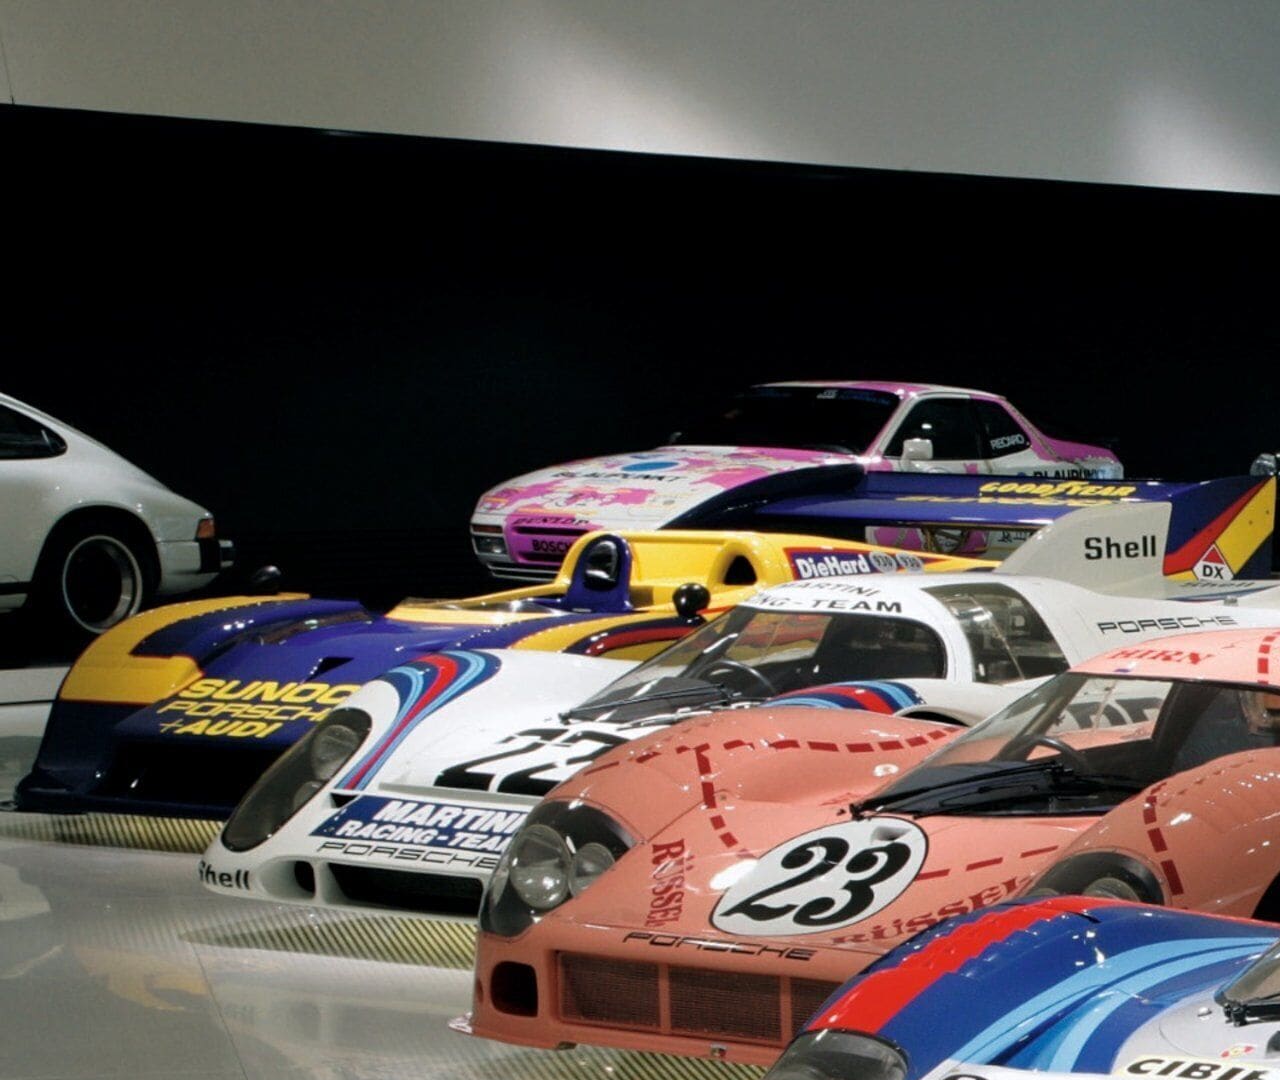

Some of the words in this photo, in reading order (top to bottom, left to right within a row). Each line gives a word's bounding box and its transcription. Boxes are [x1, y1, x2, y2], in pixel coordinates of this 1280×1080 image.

[990, 433, 1025, 449] RECARO
[979, 481, 1137, 497] GOODYEAR
[1084, 536, 1156, 560] Shell
[795, 554, 870, 578] DieHard
[1203, 564, 1223, 578] DX
[1097, 616, 1237, 634] PORSCHE
[179, 679, 363, 705] SUNOC
[157, 700, 334, 723] PORSCH
[375, 802, 527, 833] MARTINI
[335, 820, 515, 852] RACING-TEA
[719, 836, 912, 926] 23
[622, 932, 818, 961] PORSCHE
